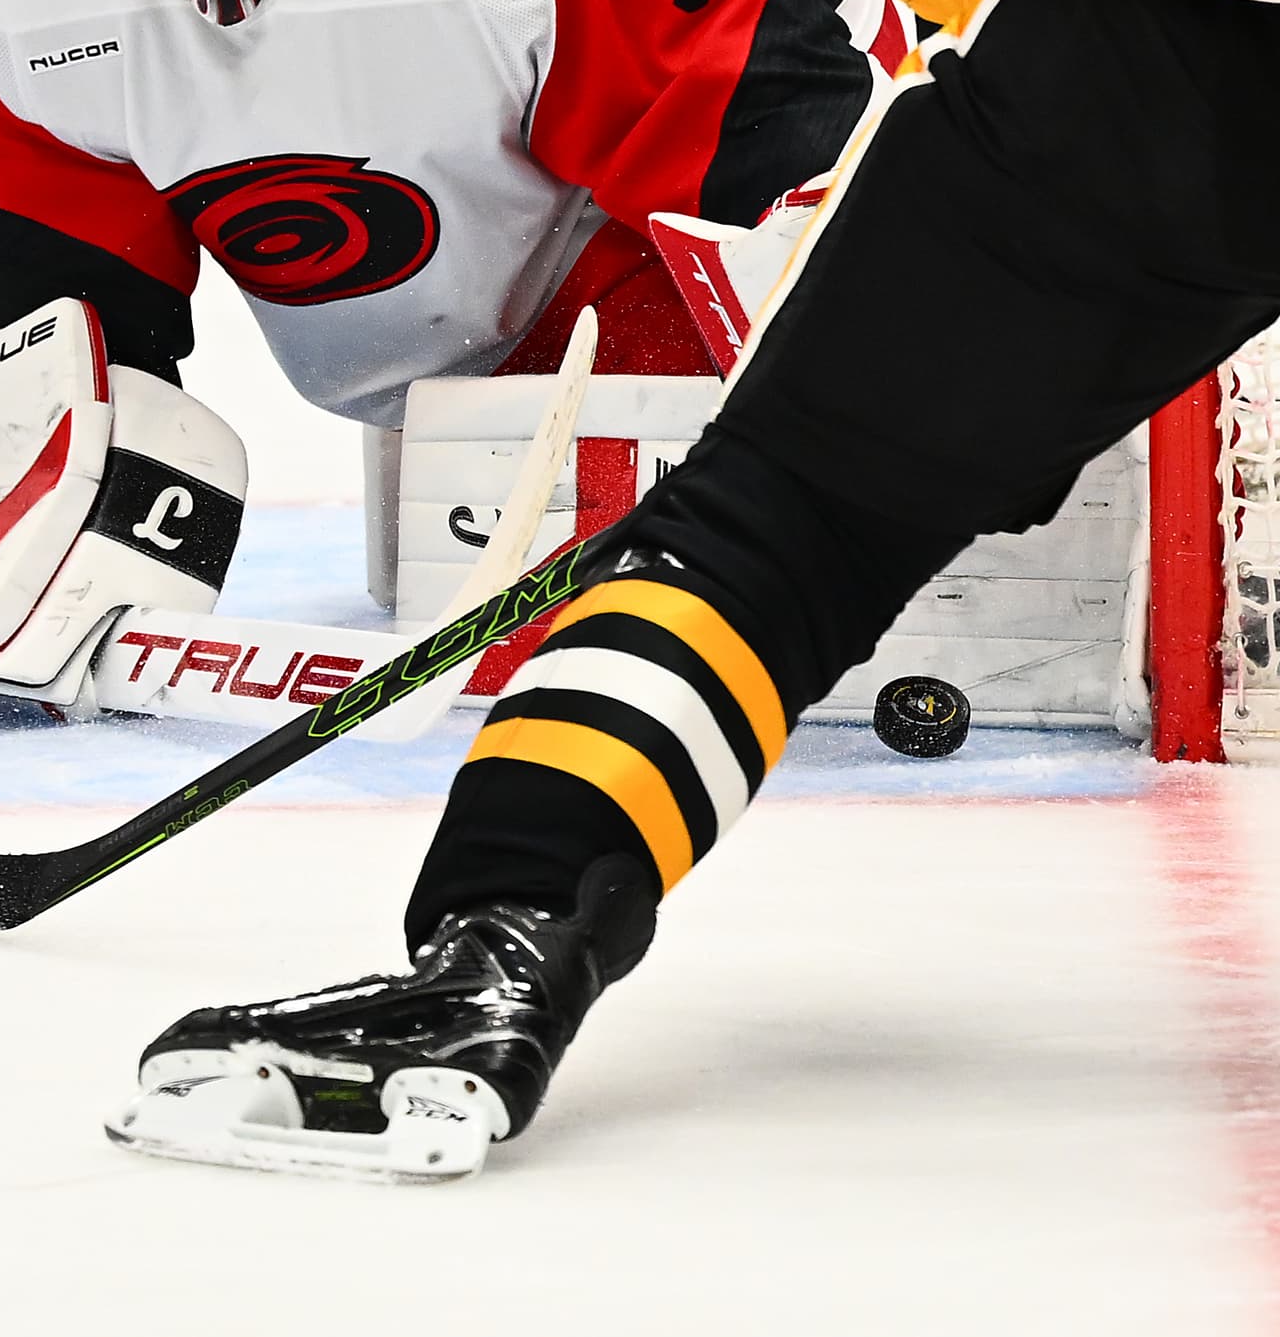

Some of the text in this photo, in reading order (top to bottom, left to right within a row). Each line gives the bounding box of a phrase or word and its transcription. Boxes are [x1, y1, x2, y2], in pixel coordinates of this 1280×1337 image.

[29, 40, 120, 72] NUCOR
[116, 630, 365, 706] TRUE
[307, 539, 587, 739] CCM
